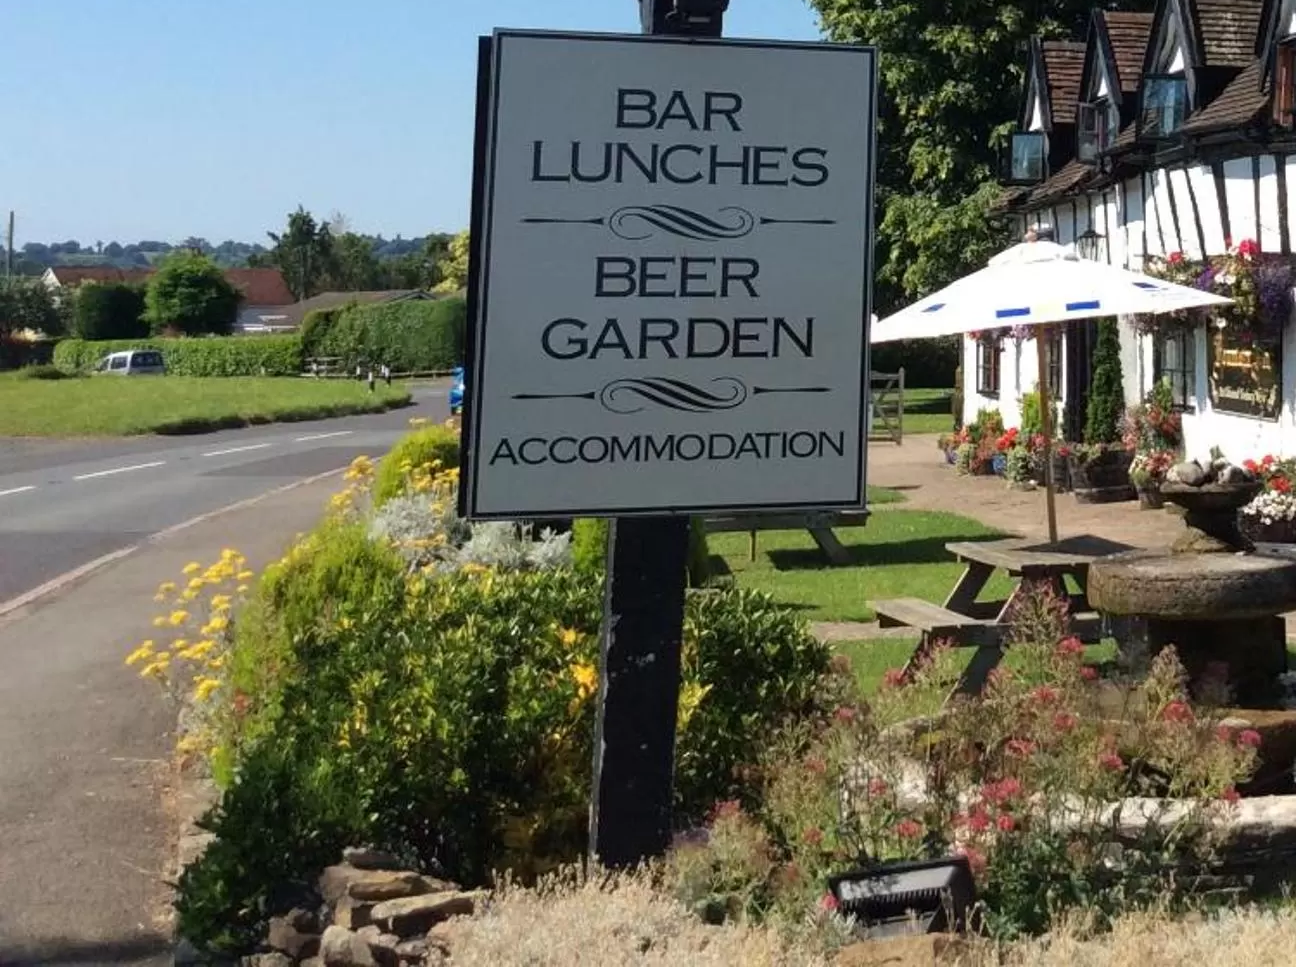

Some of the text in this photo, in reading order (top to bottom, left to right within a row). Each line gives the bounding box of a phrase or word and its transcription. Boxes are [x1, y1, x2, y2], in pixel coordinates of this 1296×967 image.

[616, 88, 743, 132] BAR
[531, 140, 829, 187] LUNCHES
[594, 256, 760, 298] BEER
[541, 316, 816, 360] GARDEN
[489, 431, 845, 466] ACCOMMODATION
